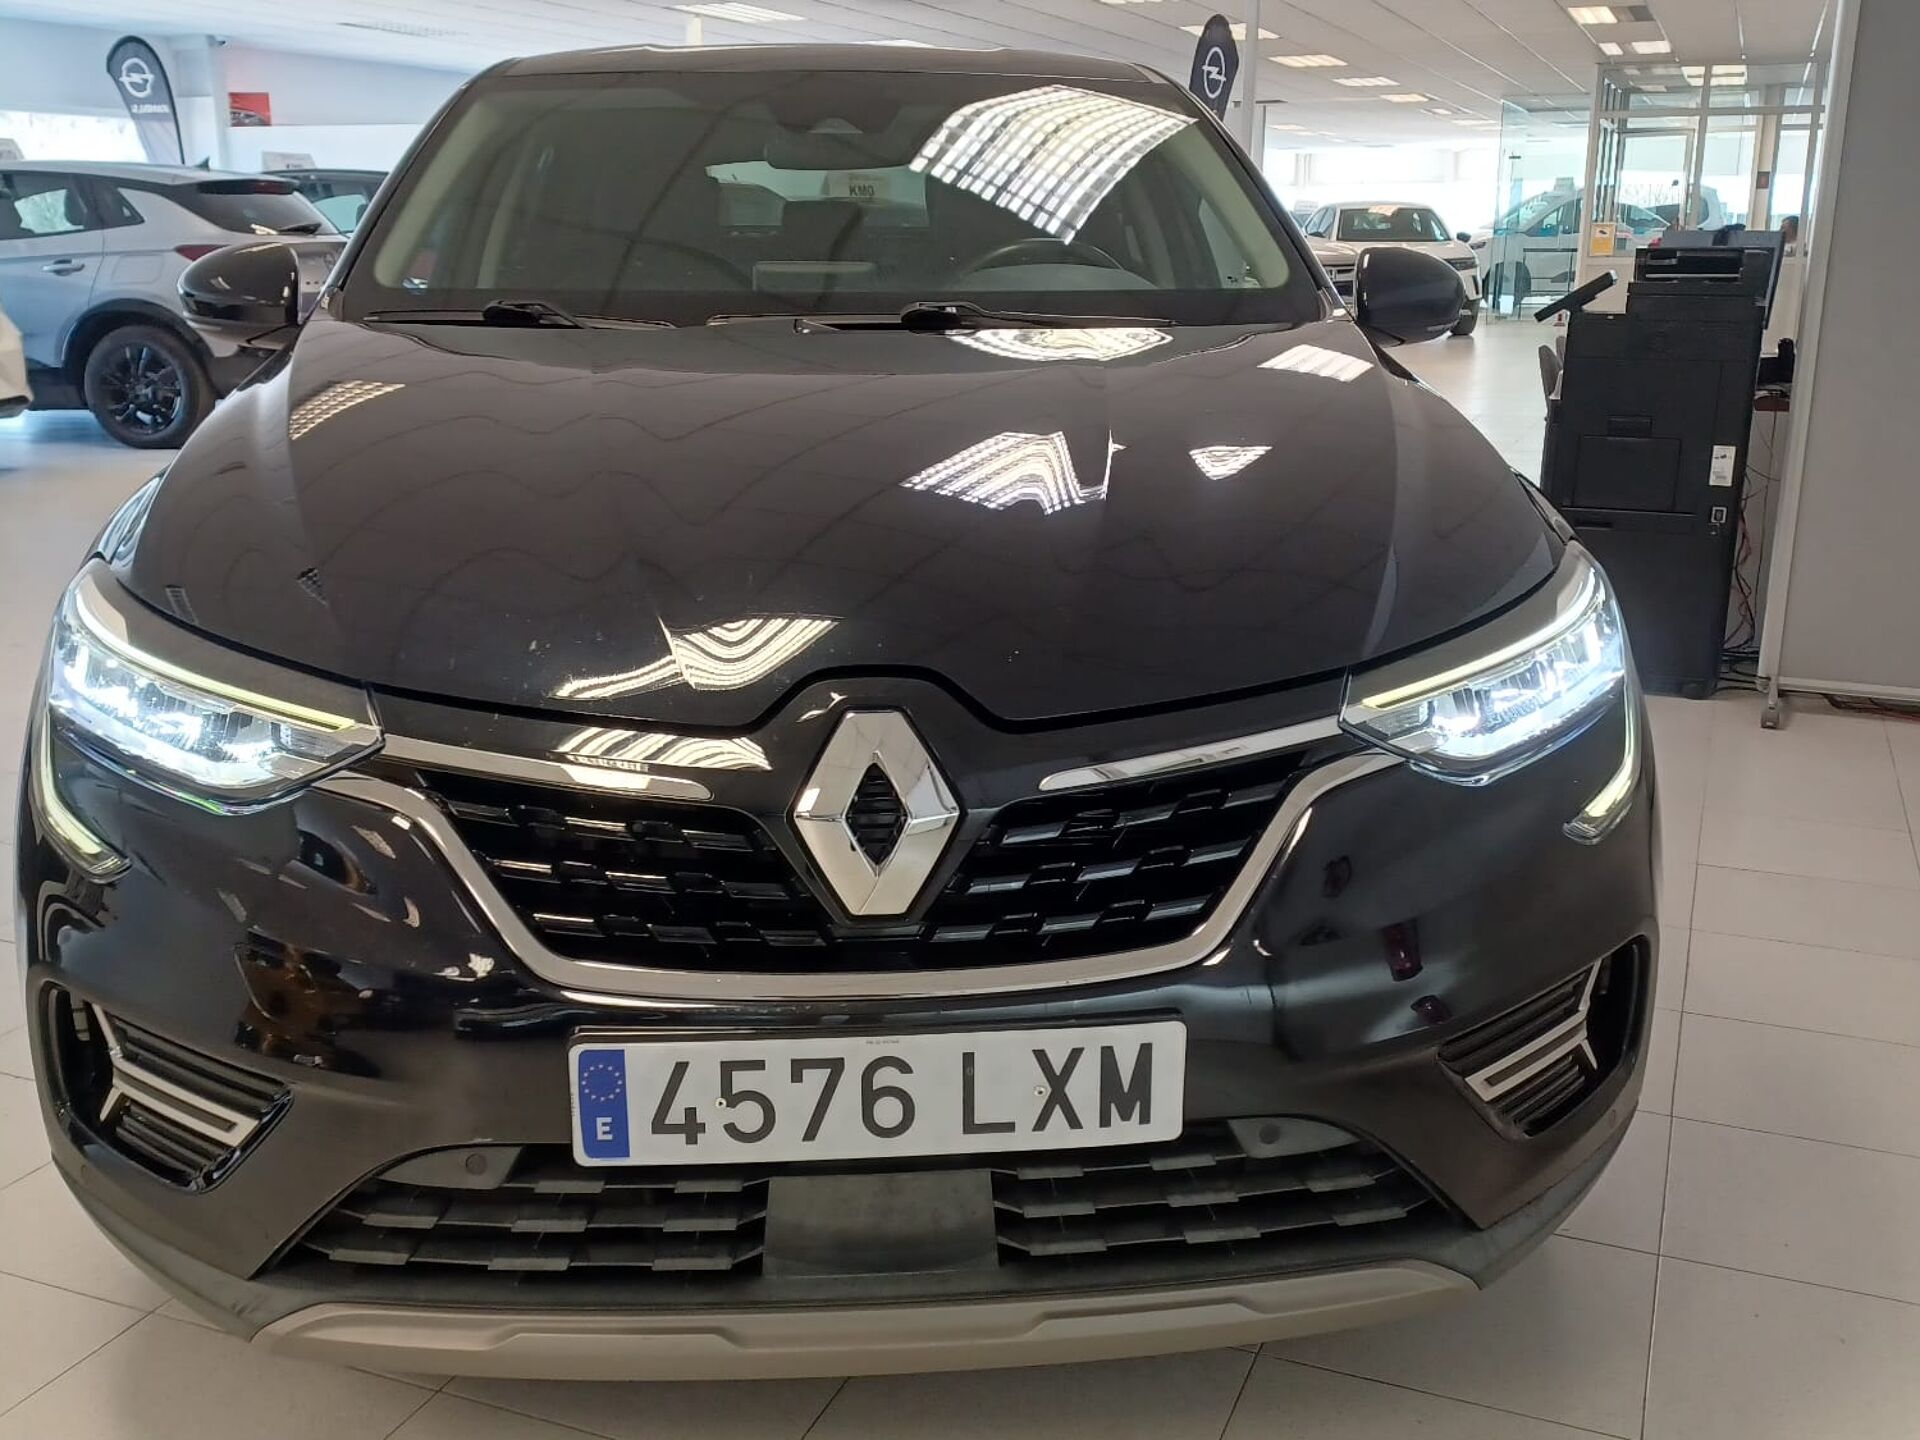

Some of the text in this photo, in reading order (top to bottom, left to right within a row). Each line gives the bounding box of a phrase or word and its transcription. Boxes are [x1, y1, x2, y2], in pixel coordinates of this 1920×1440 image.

[651, 1042, 1153, 1146] 4576 LXM
[595, 1116, 614, 1141] E
